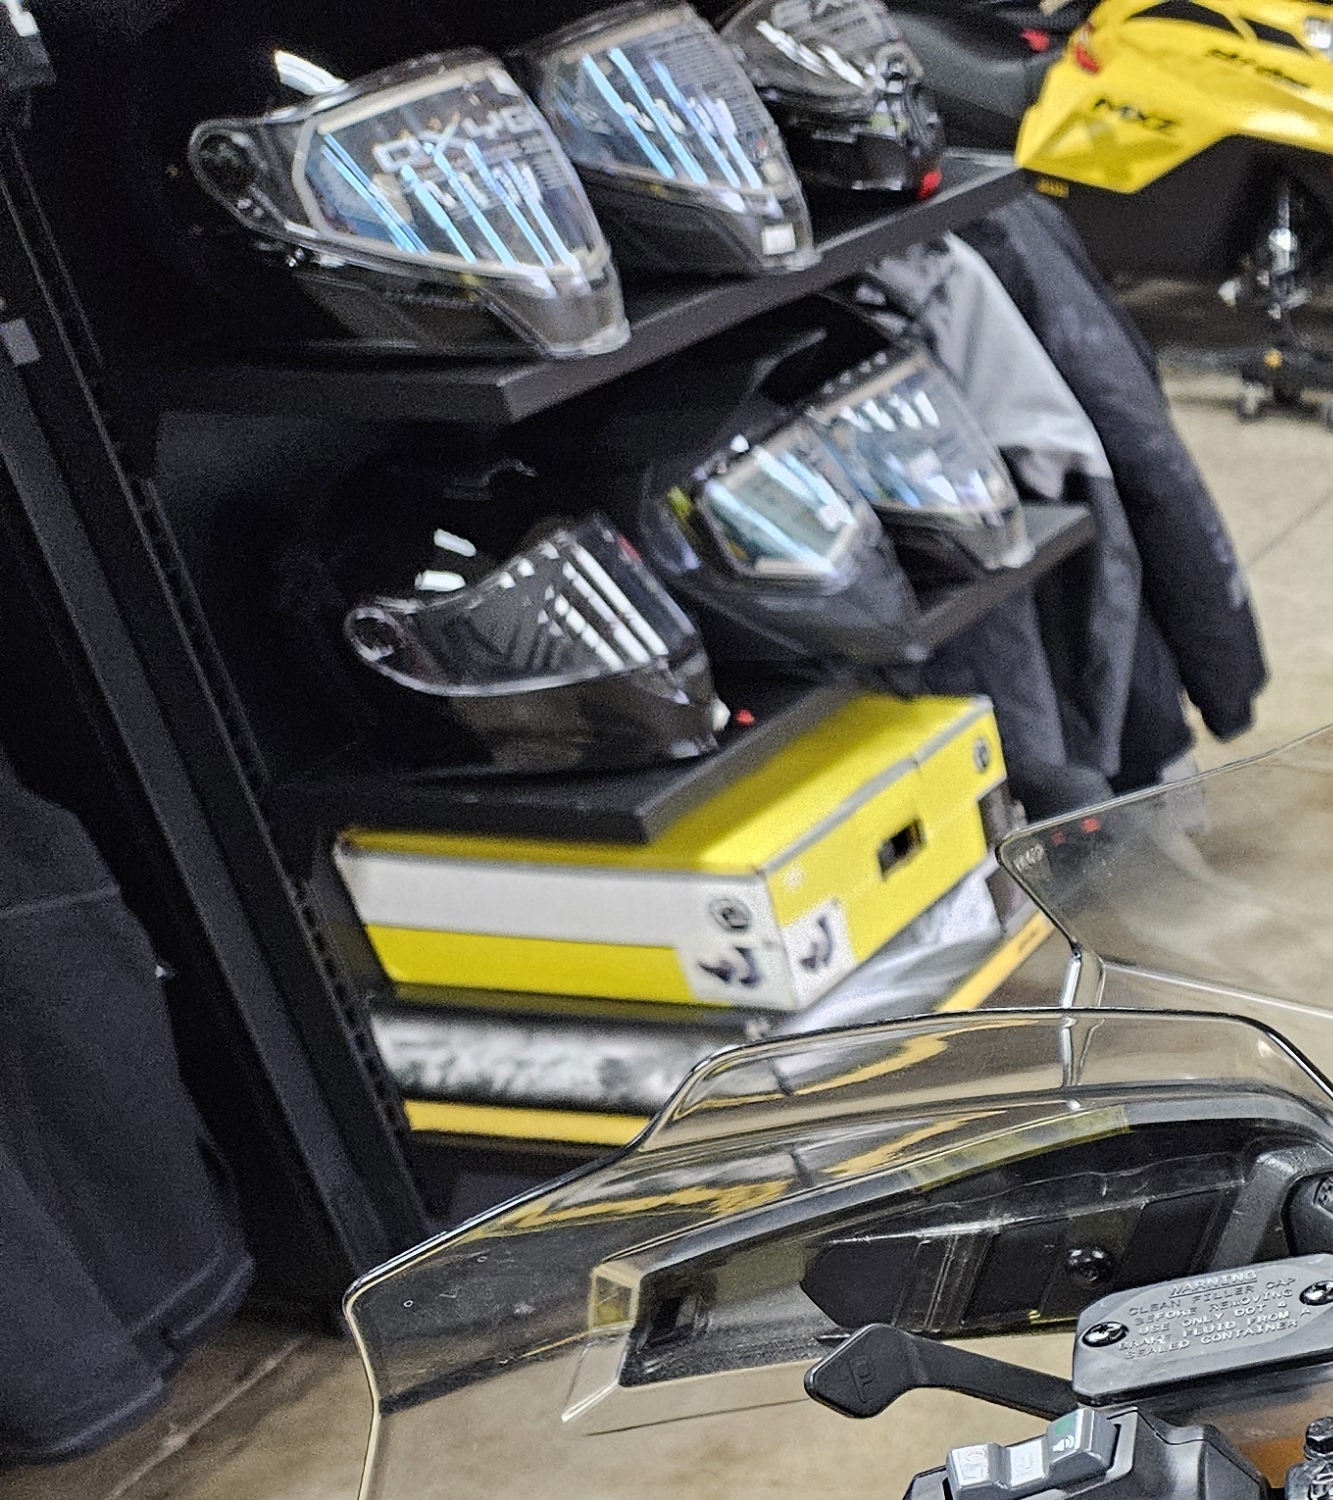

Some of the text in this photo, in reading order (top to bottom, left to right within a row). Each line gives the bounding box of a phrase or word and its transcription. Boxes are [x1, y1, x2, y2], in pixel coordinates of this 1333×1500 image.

[1129, 1277, 1297, 1317] CLEAN FILLER CAP
[1170, 1268, 1257, 1297] WARNING
[1134, 1288, 1293, 1327] BEFORE REMOVING
[1138, 1300, 1288, 1336] USE ONLY DOT 4
[1119, 1307, 1311, 1352] BRAKE FLUID FROM A
[1125, 1319, 1299, 1360] SEALED CONTAINER
